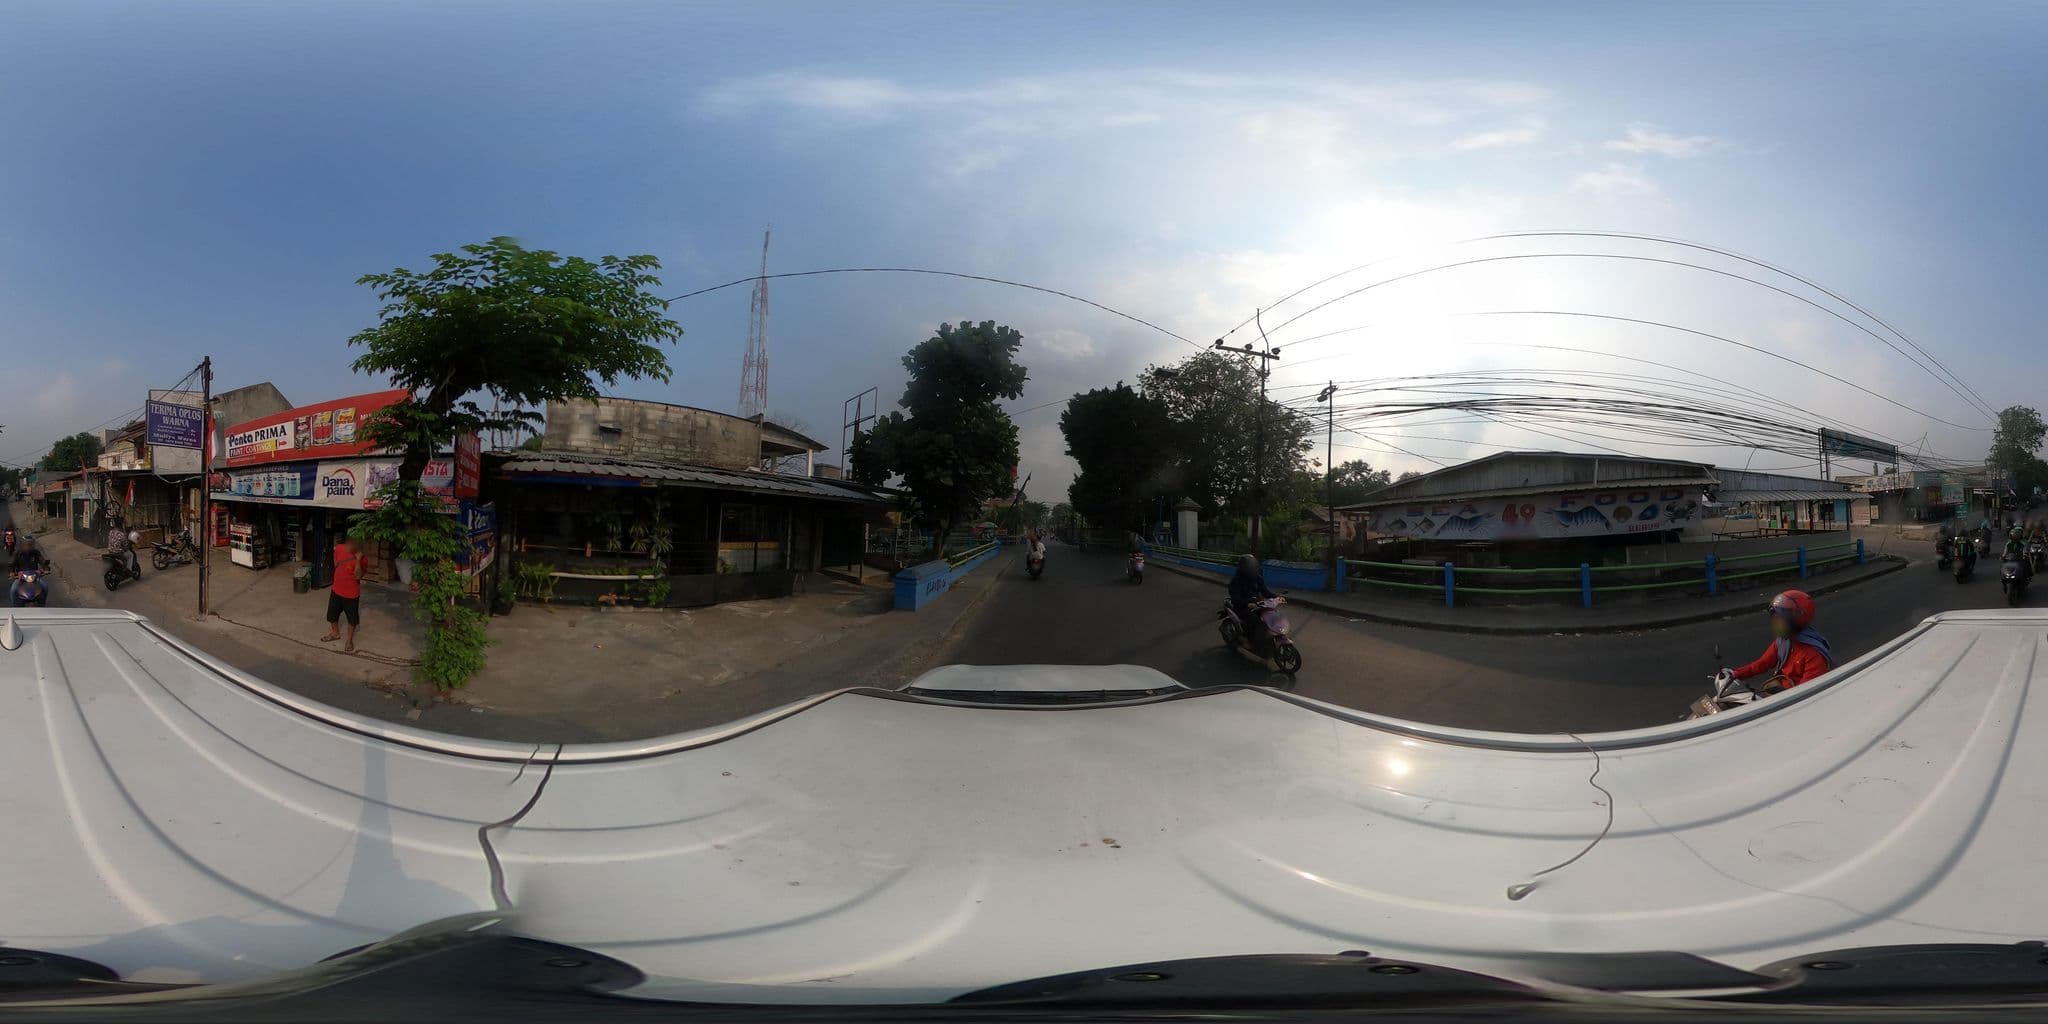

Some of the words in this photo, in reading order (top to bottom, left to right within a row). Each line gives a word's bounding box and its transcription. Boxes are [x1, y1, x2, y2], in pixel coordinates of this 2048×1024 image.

[150, 403, 177, 417] TERIMA
[178, 408, 202, 421] OPLOS
[162, 415, 190, 428] WARNA
[229, 433, 253, 447] Penta
[254, 425, 287, 442] PRIMA
[322, 476, 350, 487] Dana
[326, 484, 355, 498] paint
